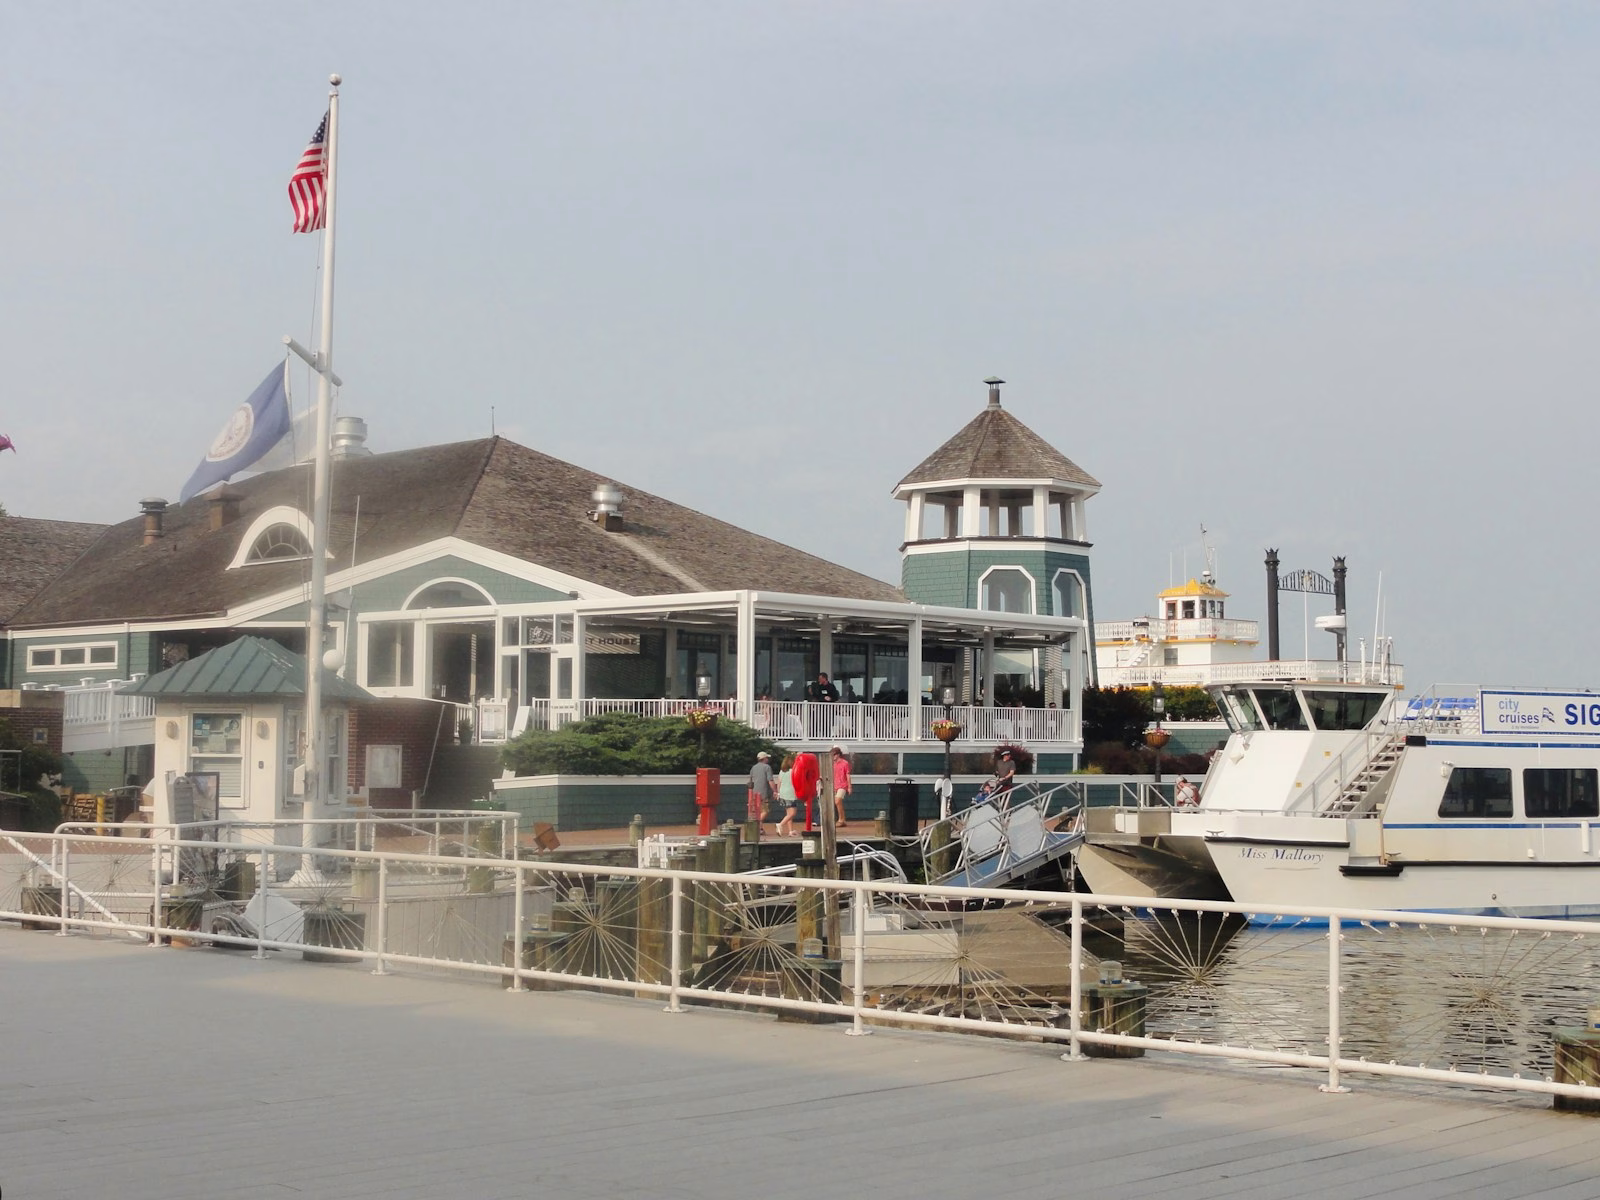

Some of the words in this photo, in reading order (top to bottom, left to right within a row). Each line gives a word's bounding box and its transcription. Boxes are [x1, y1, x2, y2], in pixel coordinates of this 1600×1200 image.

[598, 637, 638, 646] HOUSE
[1498, 698, 1519, 713] city
[1498, 712, 1540, 724] cruises
[1238, 847, 1268, 859] Miss
[1272, 848, 1324, 865] Mallory
